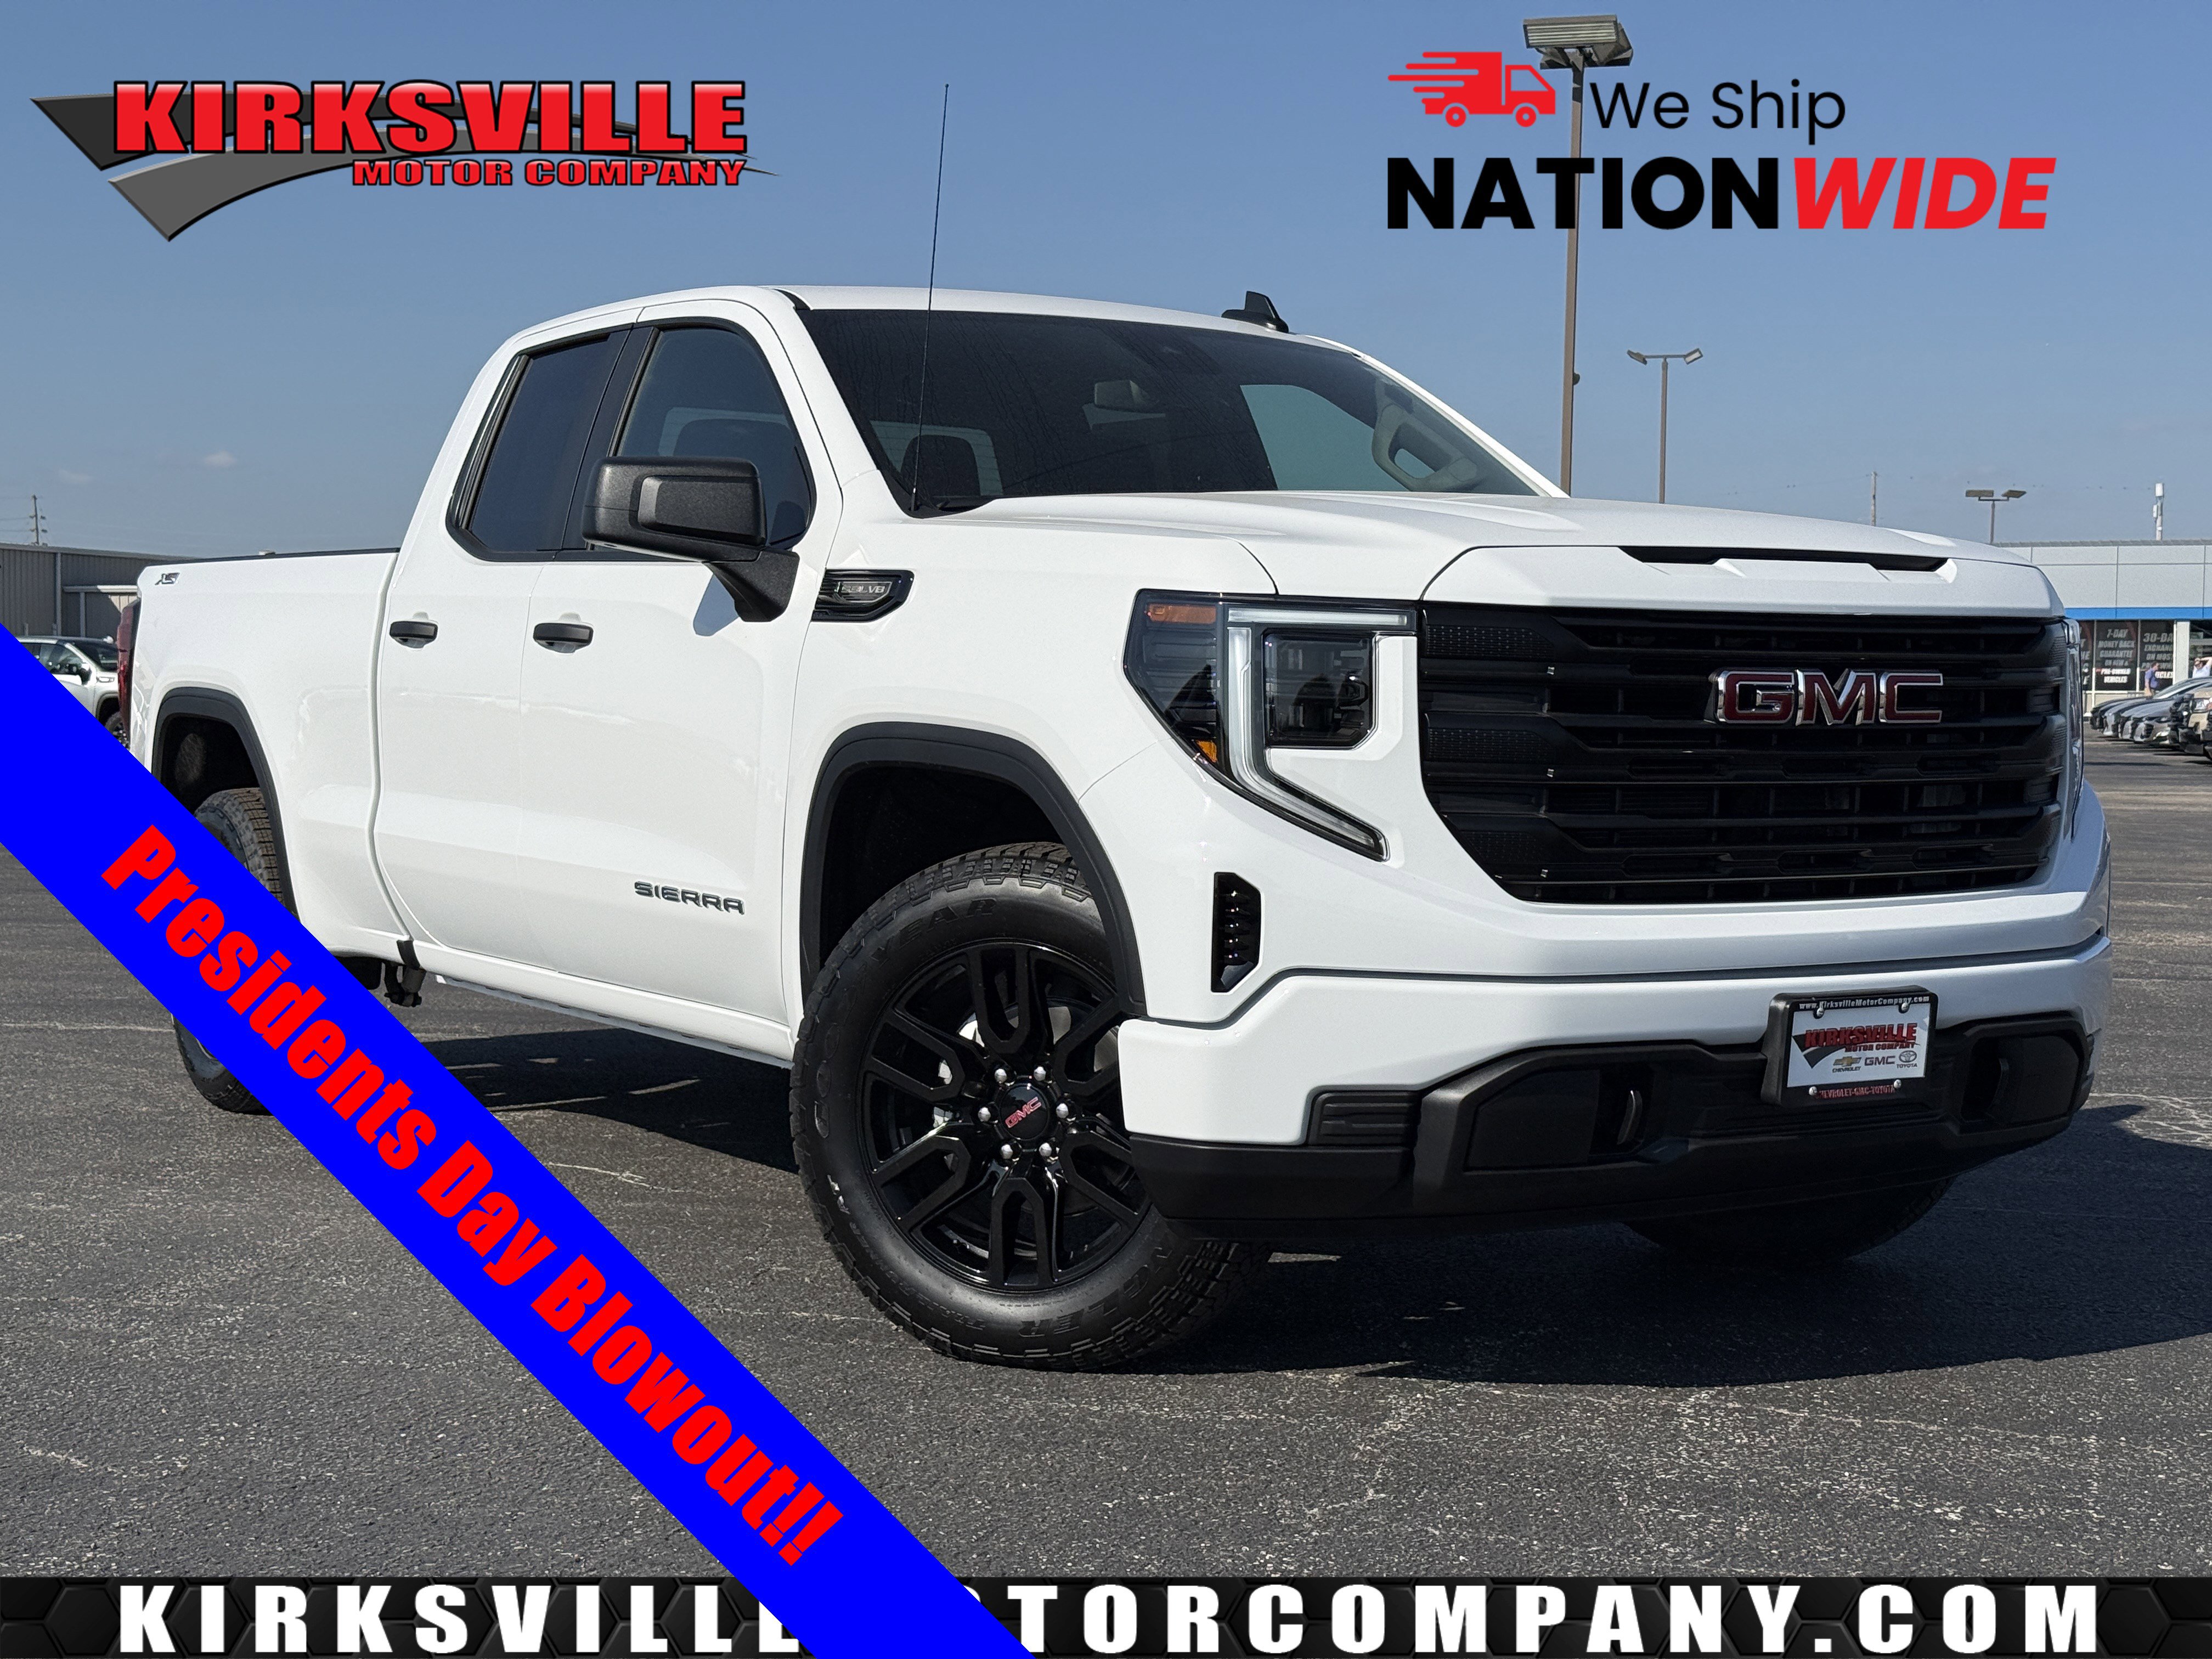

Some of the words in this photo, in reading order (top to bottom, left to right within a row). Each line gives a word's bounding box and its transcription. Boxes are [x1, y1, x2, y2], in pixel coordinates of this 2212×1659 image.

[2107, 629, 2129, 638] 7-DAY
[2142, 633, 2173, 642] 30-DA
[1717, 668, 1943, 726] GMC
[634, 881, 745, 915] SIERRA
[1804, 1023, 1918, 1047] KIRKSVILLE
[1844, 1043, 1874, 1053] MOTOR
[1875, 1042, 1915, 1051] COMPANY
[1865, 1056, 1896, 1066] GMC
[1005, 1096, 1042, 1128] GMC
